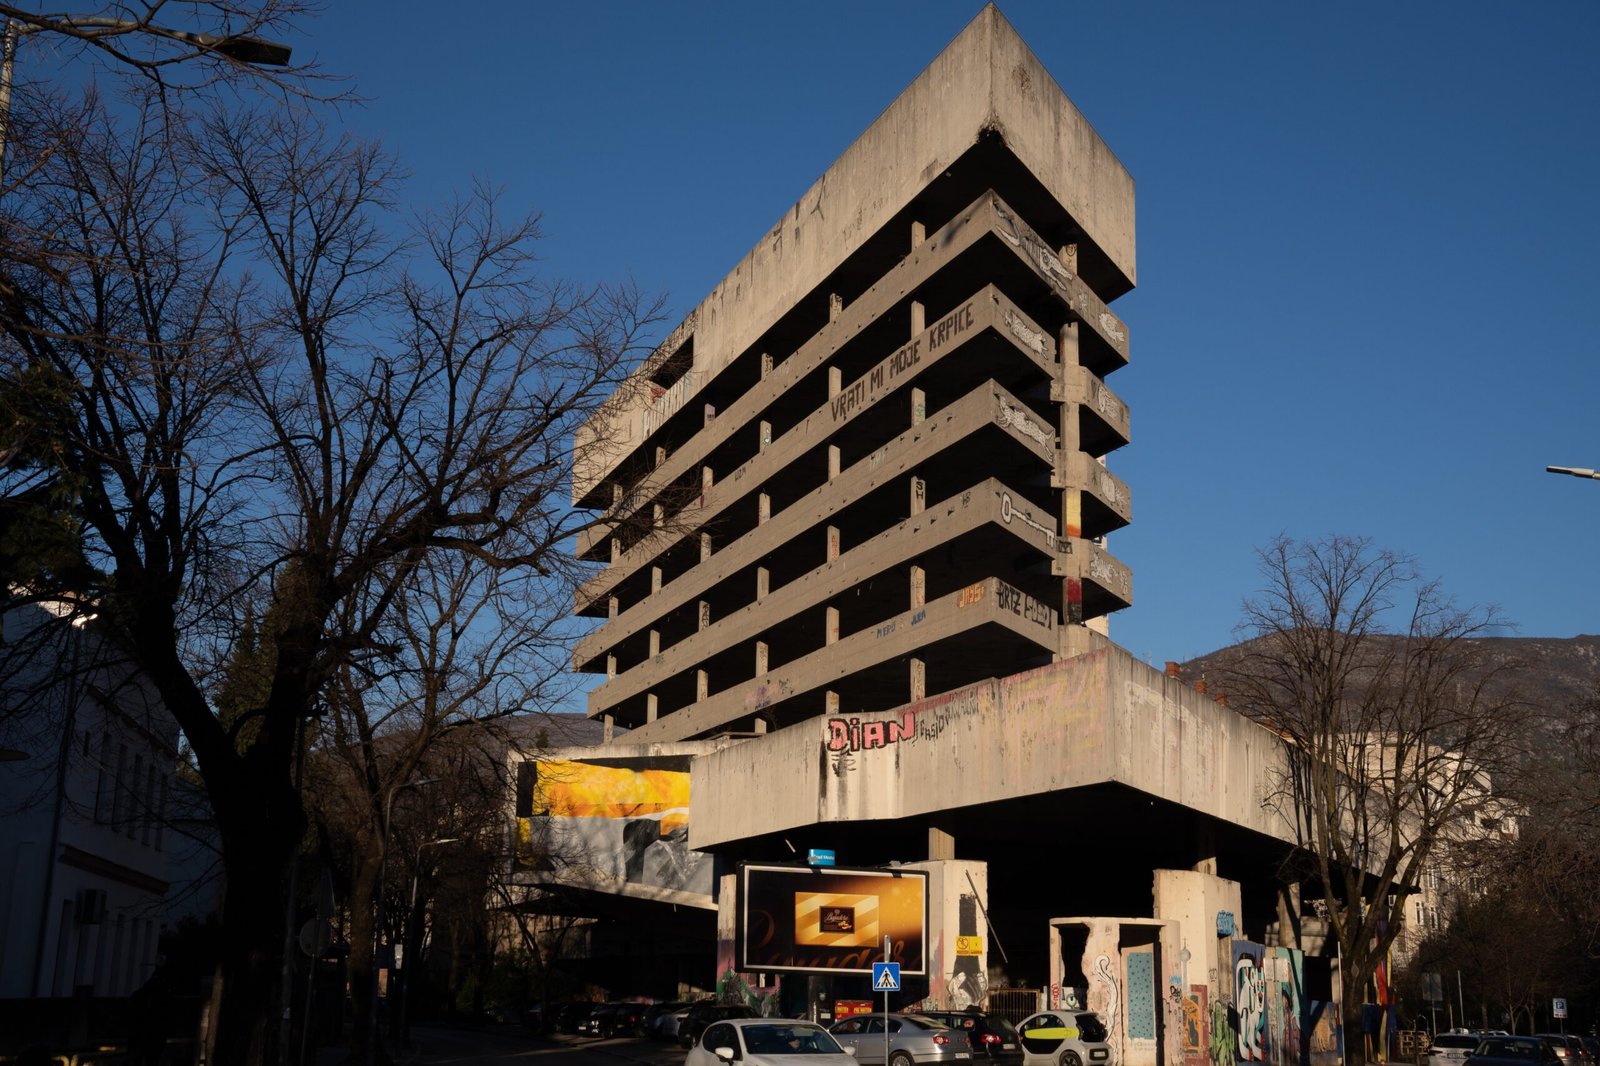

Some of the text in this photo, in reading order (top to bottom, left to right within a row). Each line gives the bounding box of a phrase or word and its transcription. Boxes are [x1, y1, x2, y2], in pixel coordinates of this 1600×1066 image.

[831, 302, 975, 422] VRATI MI MOJE KRPICE
